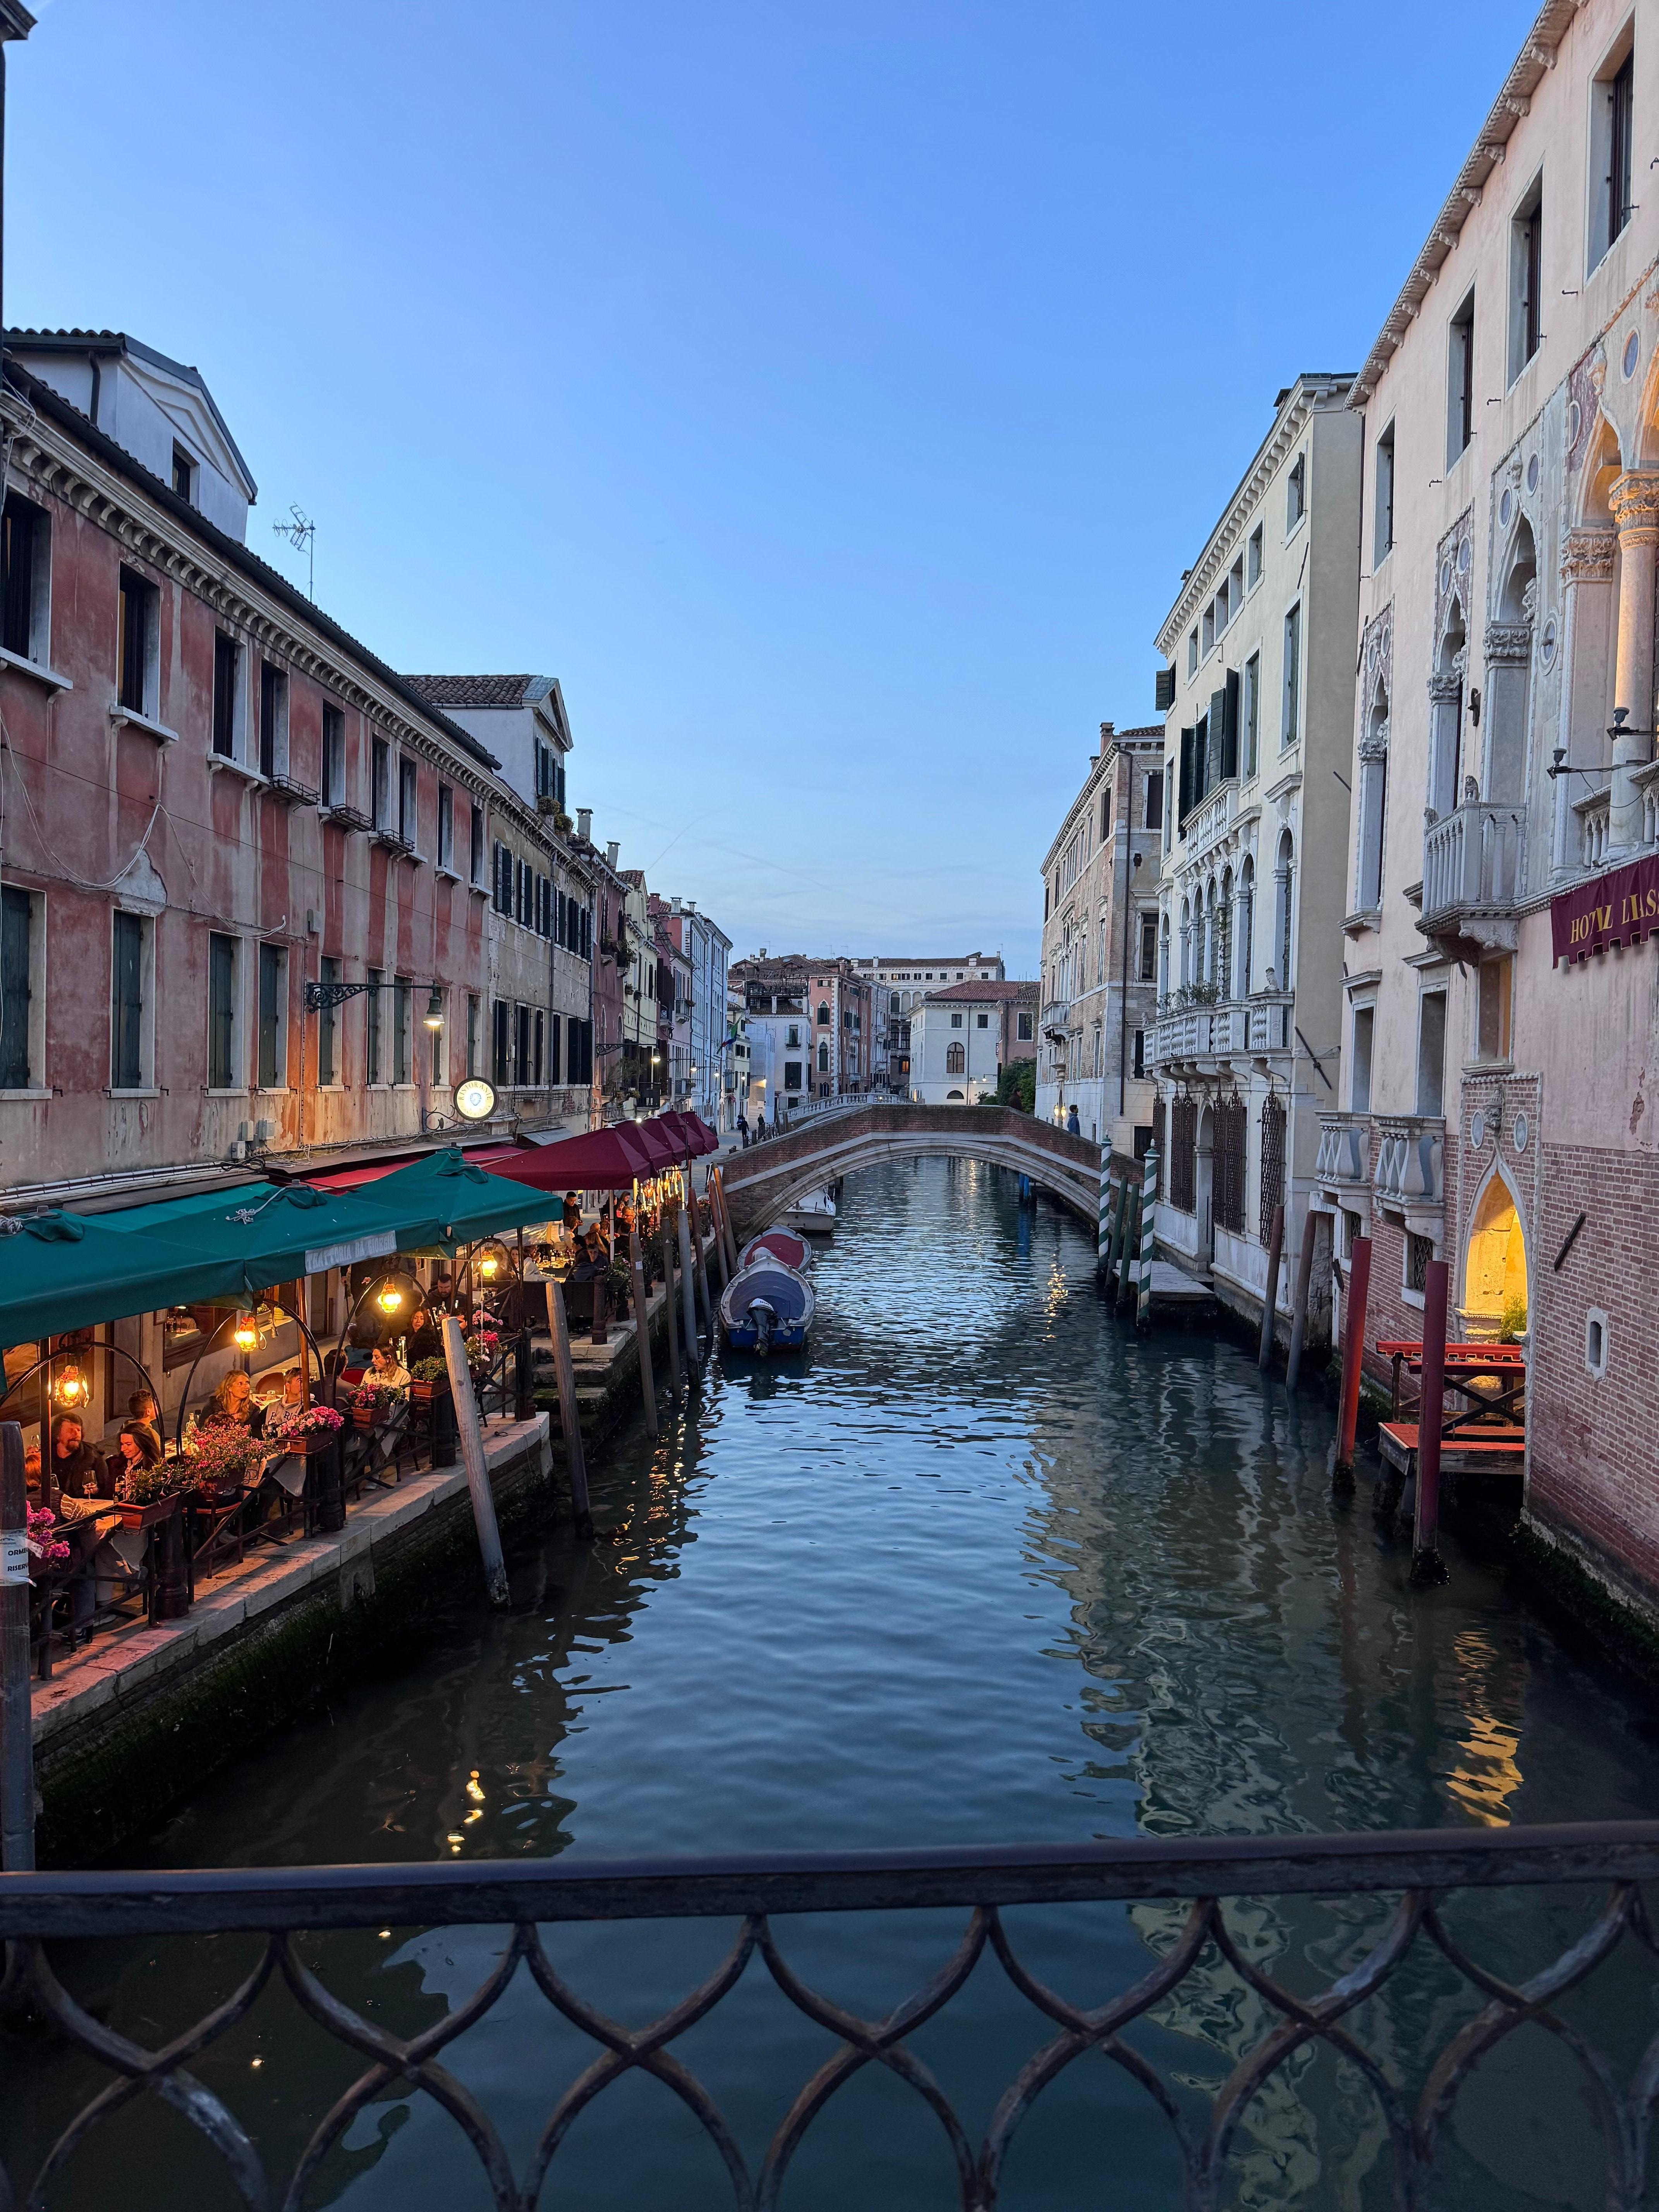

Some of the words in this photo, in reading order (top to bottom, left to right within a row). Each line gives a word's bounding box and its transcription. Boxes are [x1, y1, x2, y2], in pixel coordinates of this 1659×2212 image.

[458, 1081, 493, 1100] RISTORANTE
[306, 1244, 352, 1270] TRATTORIA
[368, 1233, 396, 1254] GIORGIO
